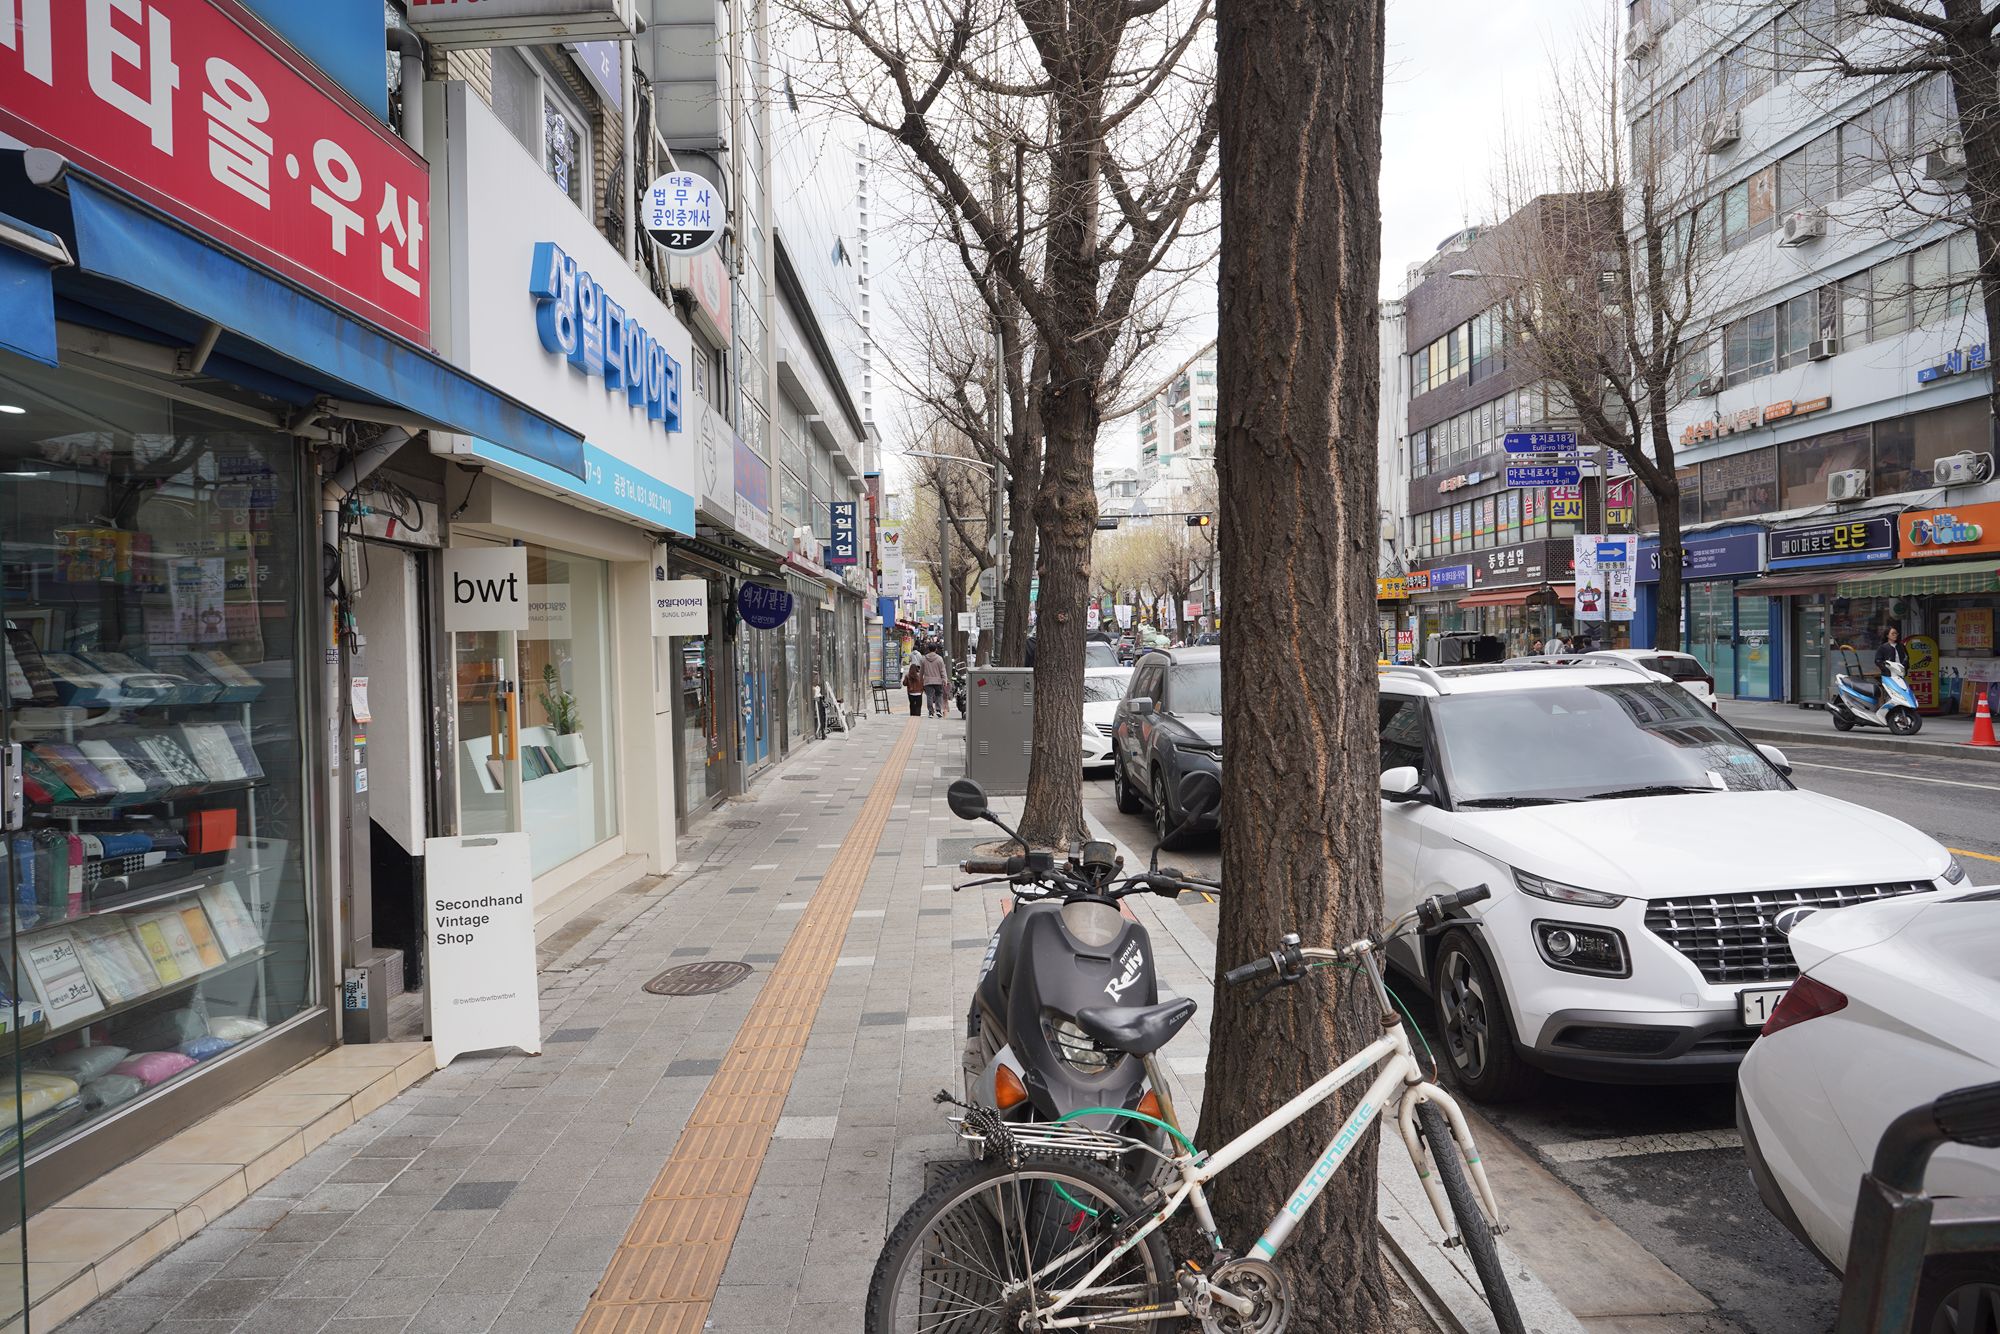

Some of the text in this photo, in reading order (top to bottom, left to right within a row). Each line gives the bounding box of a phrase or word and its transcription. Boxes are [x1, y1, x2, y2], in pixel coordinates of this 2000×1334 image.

[652, 208, 711, 227] 공인중개사
[670, 233, 692, 246] 2F
[532, 243, 682, 433] 성일다이어리
[1530, 434, 1575, 444] 을지로18길
[1557, 443, 1575, 451] 18-gil
[1509, 468, 1559, 478] 마른내로4길
[614, 472, 626, 498] 공장
[1552, 501, 1581, 517] 실사
[835, 504, 852, 556] 제일기업
[1834, 523, 1867, 549] 모든
[1932, 523, 1978, 544] Lotto
[1488, 549, 1524, 569] 동방실업
[453, 571, 518, 604] bwt
[656, 598, 703, 608] 성일다이어리
[435, 893, 523, 913] Secondhand
[436, 912, 490, 930] Vintage
[436, 931, 474, 947] Shop
[1103, 948, 1144, 1002] Rally
[1169, 1009, 1188, 1025] ALTON
[1288, 1103, 1375, 1217] ALTONBIKE
[1127, 1303, 1160, 1313] ALTON
